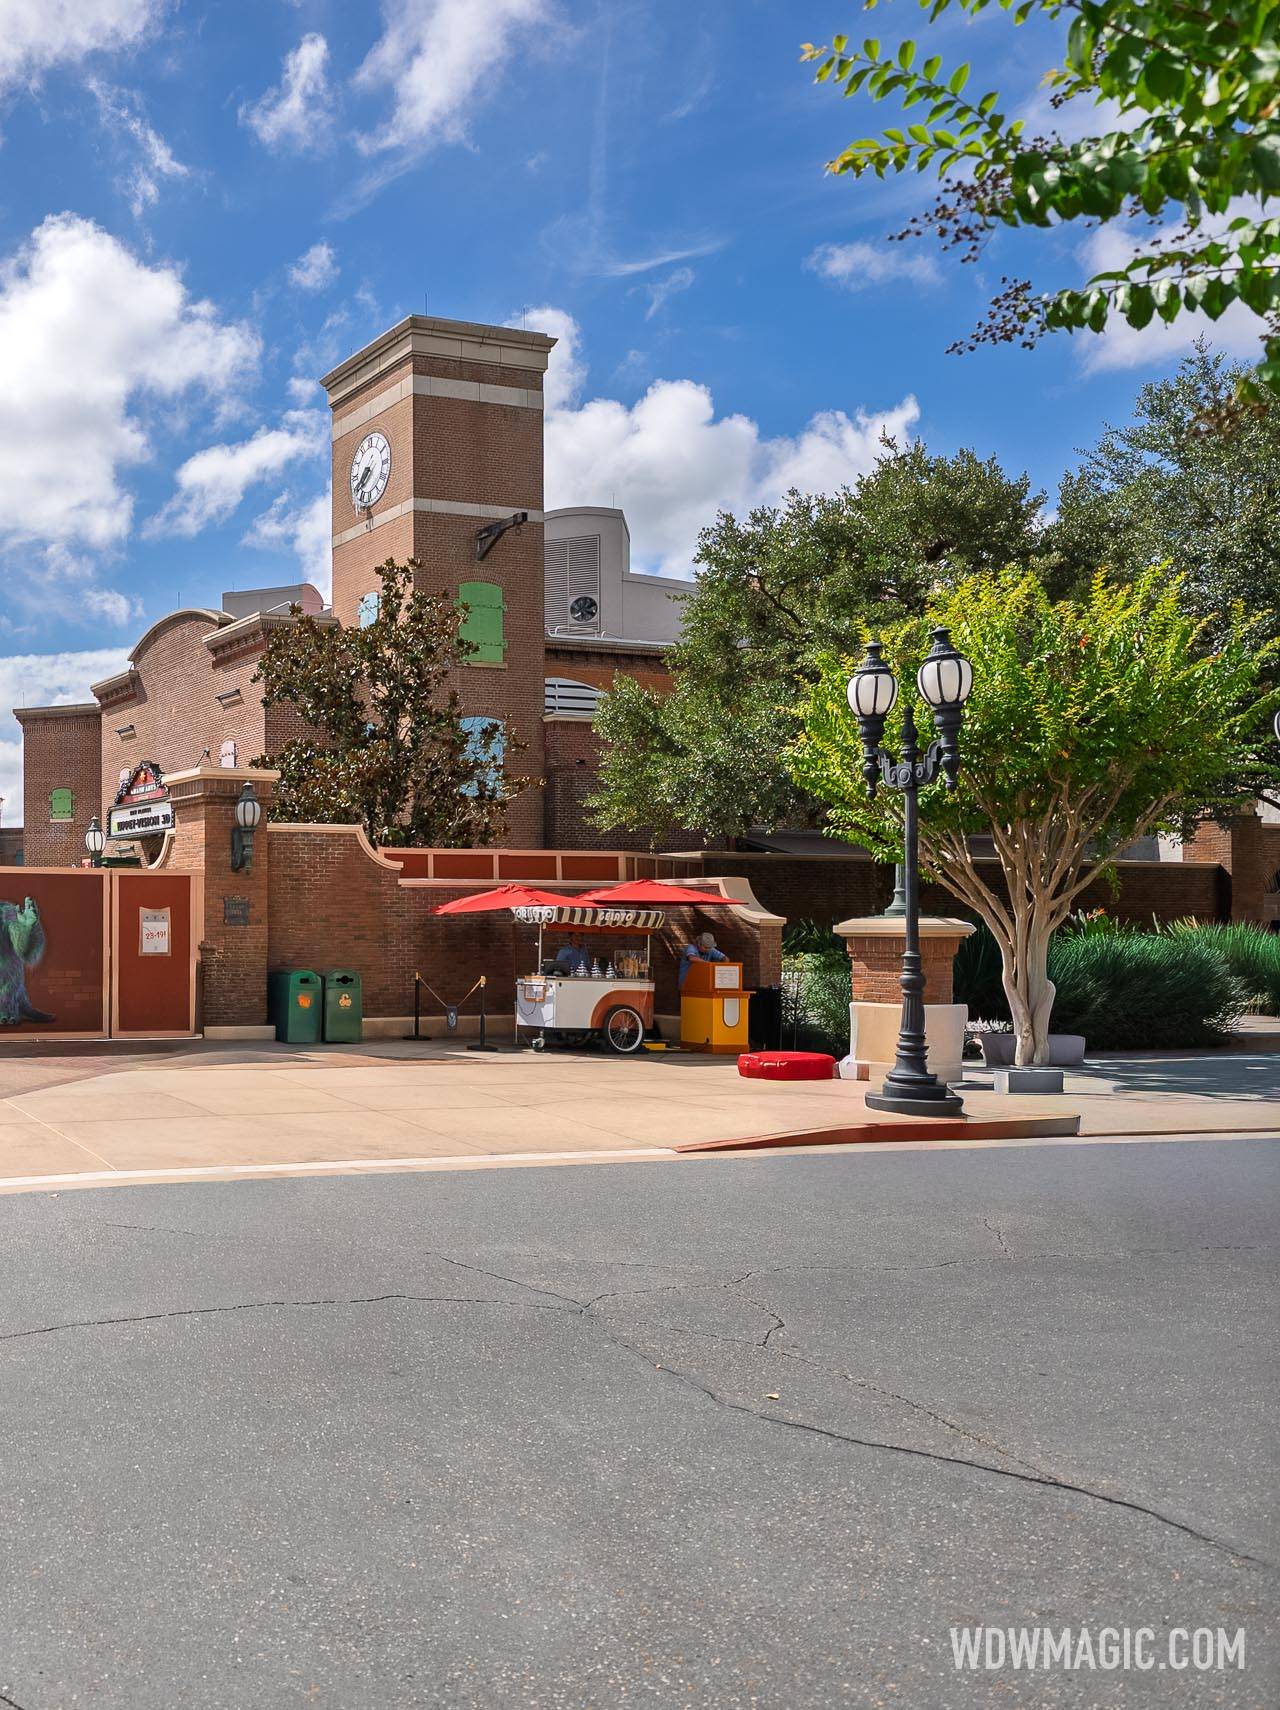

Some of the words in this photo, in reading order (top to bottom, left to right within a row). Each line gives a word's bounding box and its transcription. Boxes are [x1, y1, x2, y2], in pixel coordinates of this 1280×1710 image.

[161, 814, 171, 825] 3D
[598, 911, 634, 921] GELATO
[145, 930, 167, 940] 23-19!
